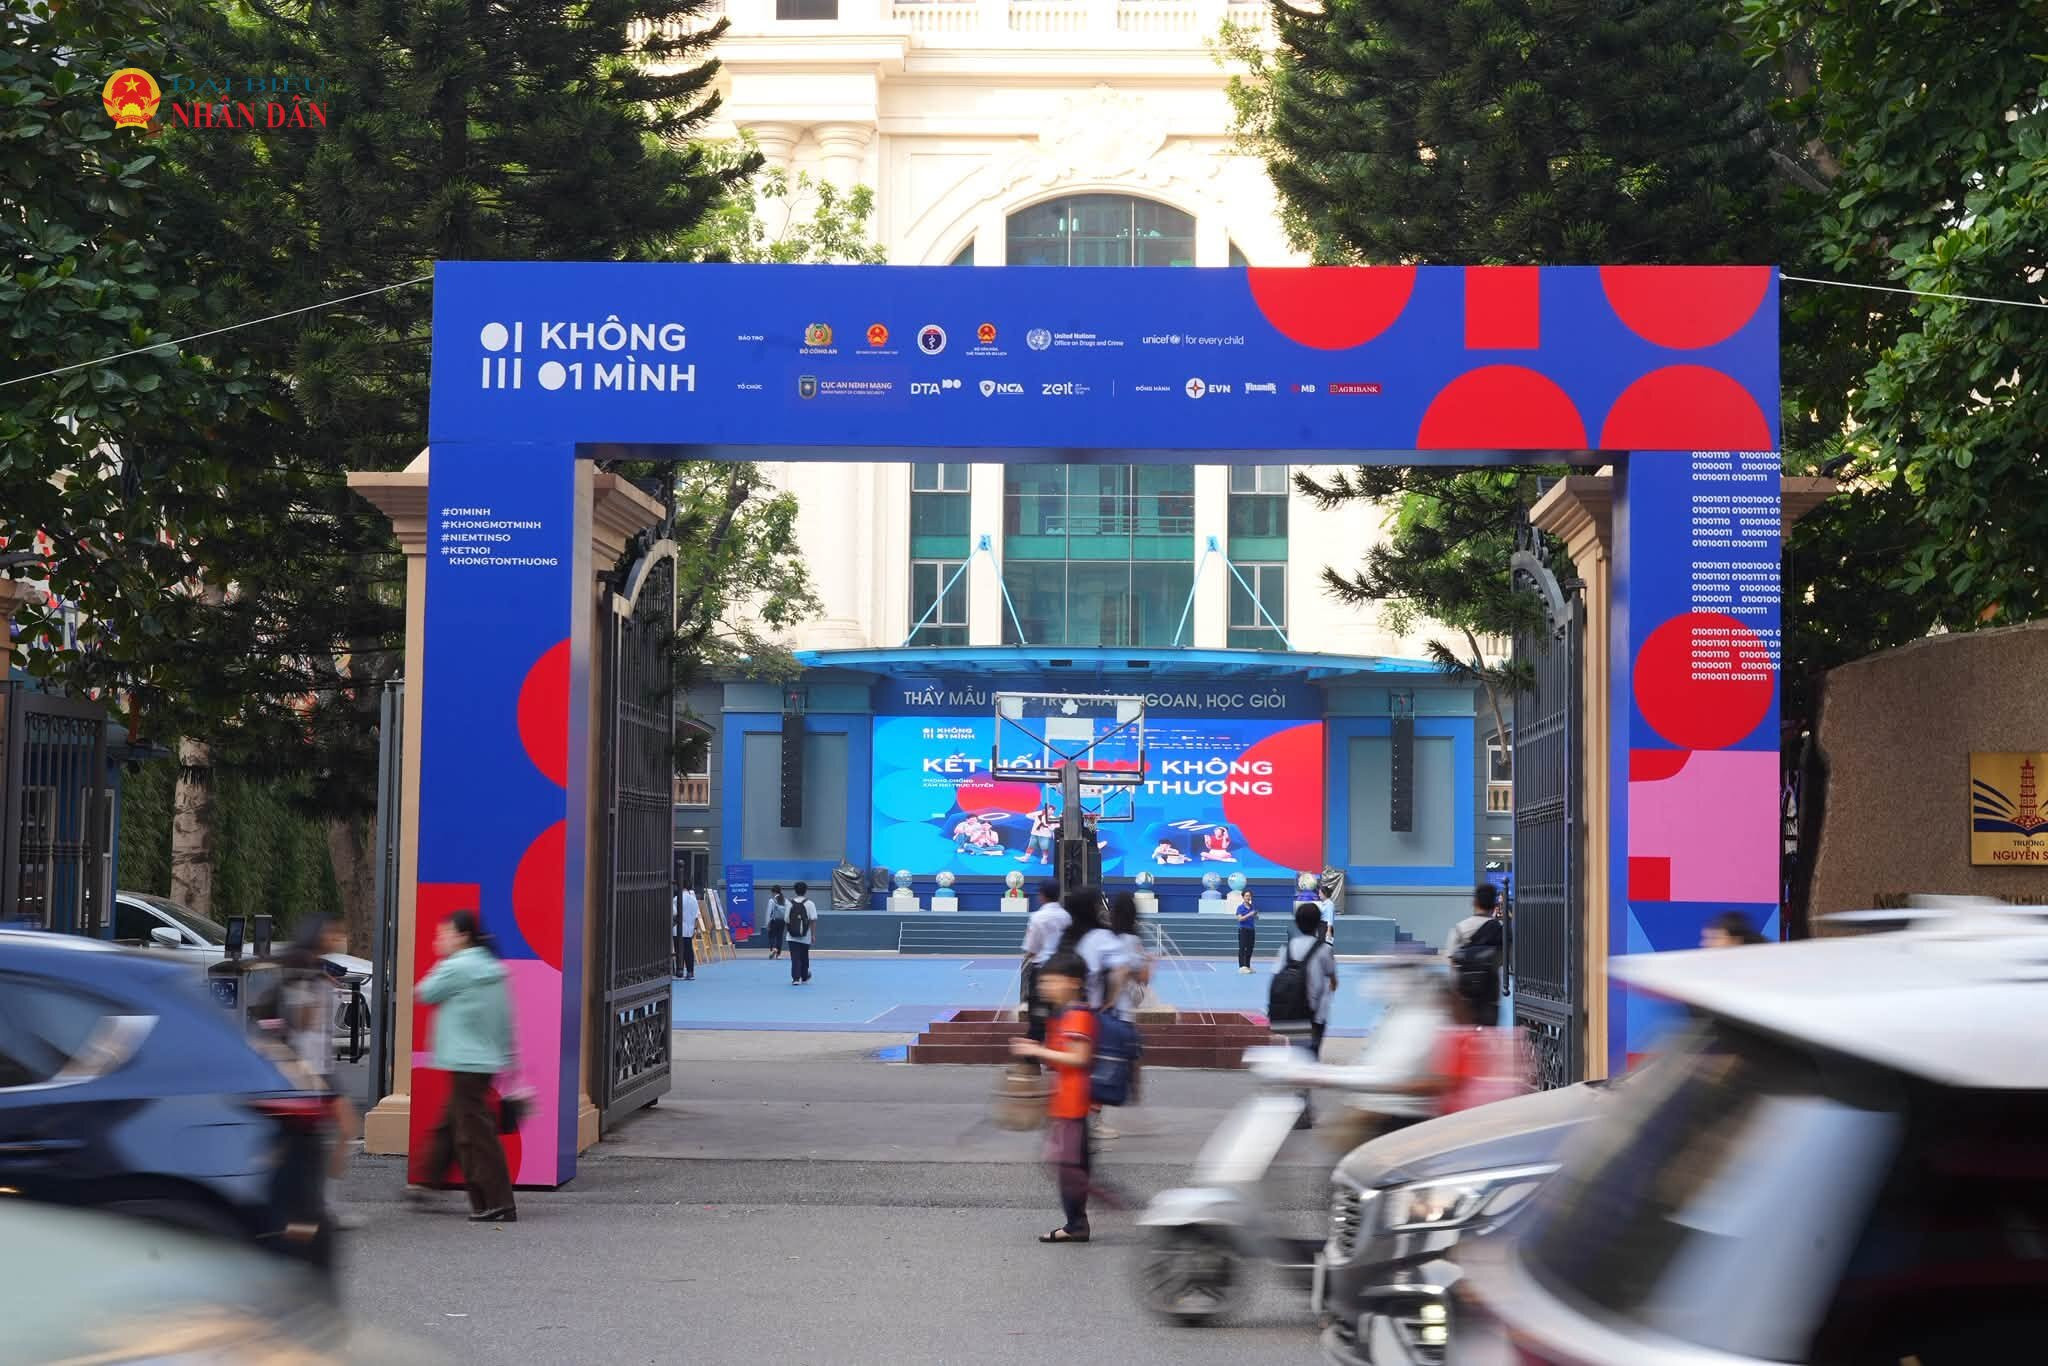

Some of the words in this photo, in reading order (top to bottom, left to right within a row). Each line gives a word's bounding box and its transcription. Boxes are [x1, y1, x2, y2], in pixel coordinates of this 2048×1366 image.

[540, 315, 686, 352] KHÔNG
[1079, 340, 1096, 348] Drugs
[1142, 335, 1170, 345] unicef
[1185, 335, 1197, 345] for
[1198, 337, 1223, 347] every
[1224, 335, 1245, 345] child
[594, 355, 696, 392] MÌNH
[911, 383, 940, 395] DTA
[997, 384, 1024, 393] NCA
[1209, 385, 1231, 393] EVN
[1301, 385, 1316, 393] MB
[1338, 385, 1378, 393] AGRIBANK
[1732, 496, 1774, 504] 01001000
[441, 520, 542, 530] #KHONGMOTMINH
[441, 533, 511, 543] #NIEMTINSO
[441, 546, 491, 555] #KETNOI
[449, 557, 558, 567] KHONGTONTHUONG
[1732, 562, 1774, 570] 01001000
[1732, 629, 1774, 637] 01001000
[904, 686, 945, 706] THẦY
[949, 686, 986, 706] MẪU
[1135, 693, 1201, 709] GOAN,
[1206, 694, 1244, 711] HỌC
[1250, 688, 1286, 708] GIỎI
[923, 753, 982, 773] KẾT
[1162, 757, 1273, 775] KHÔNG
[1144, 779, 1273, 795] THƯƠNG
